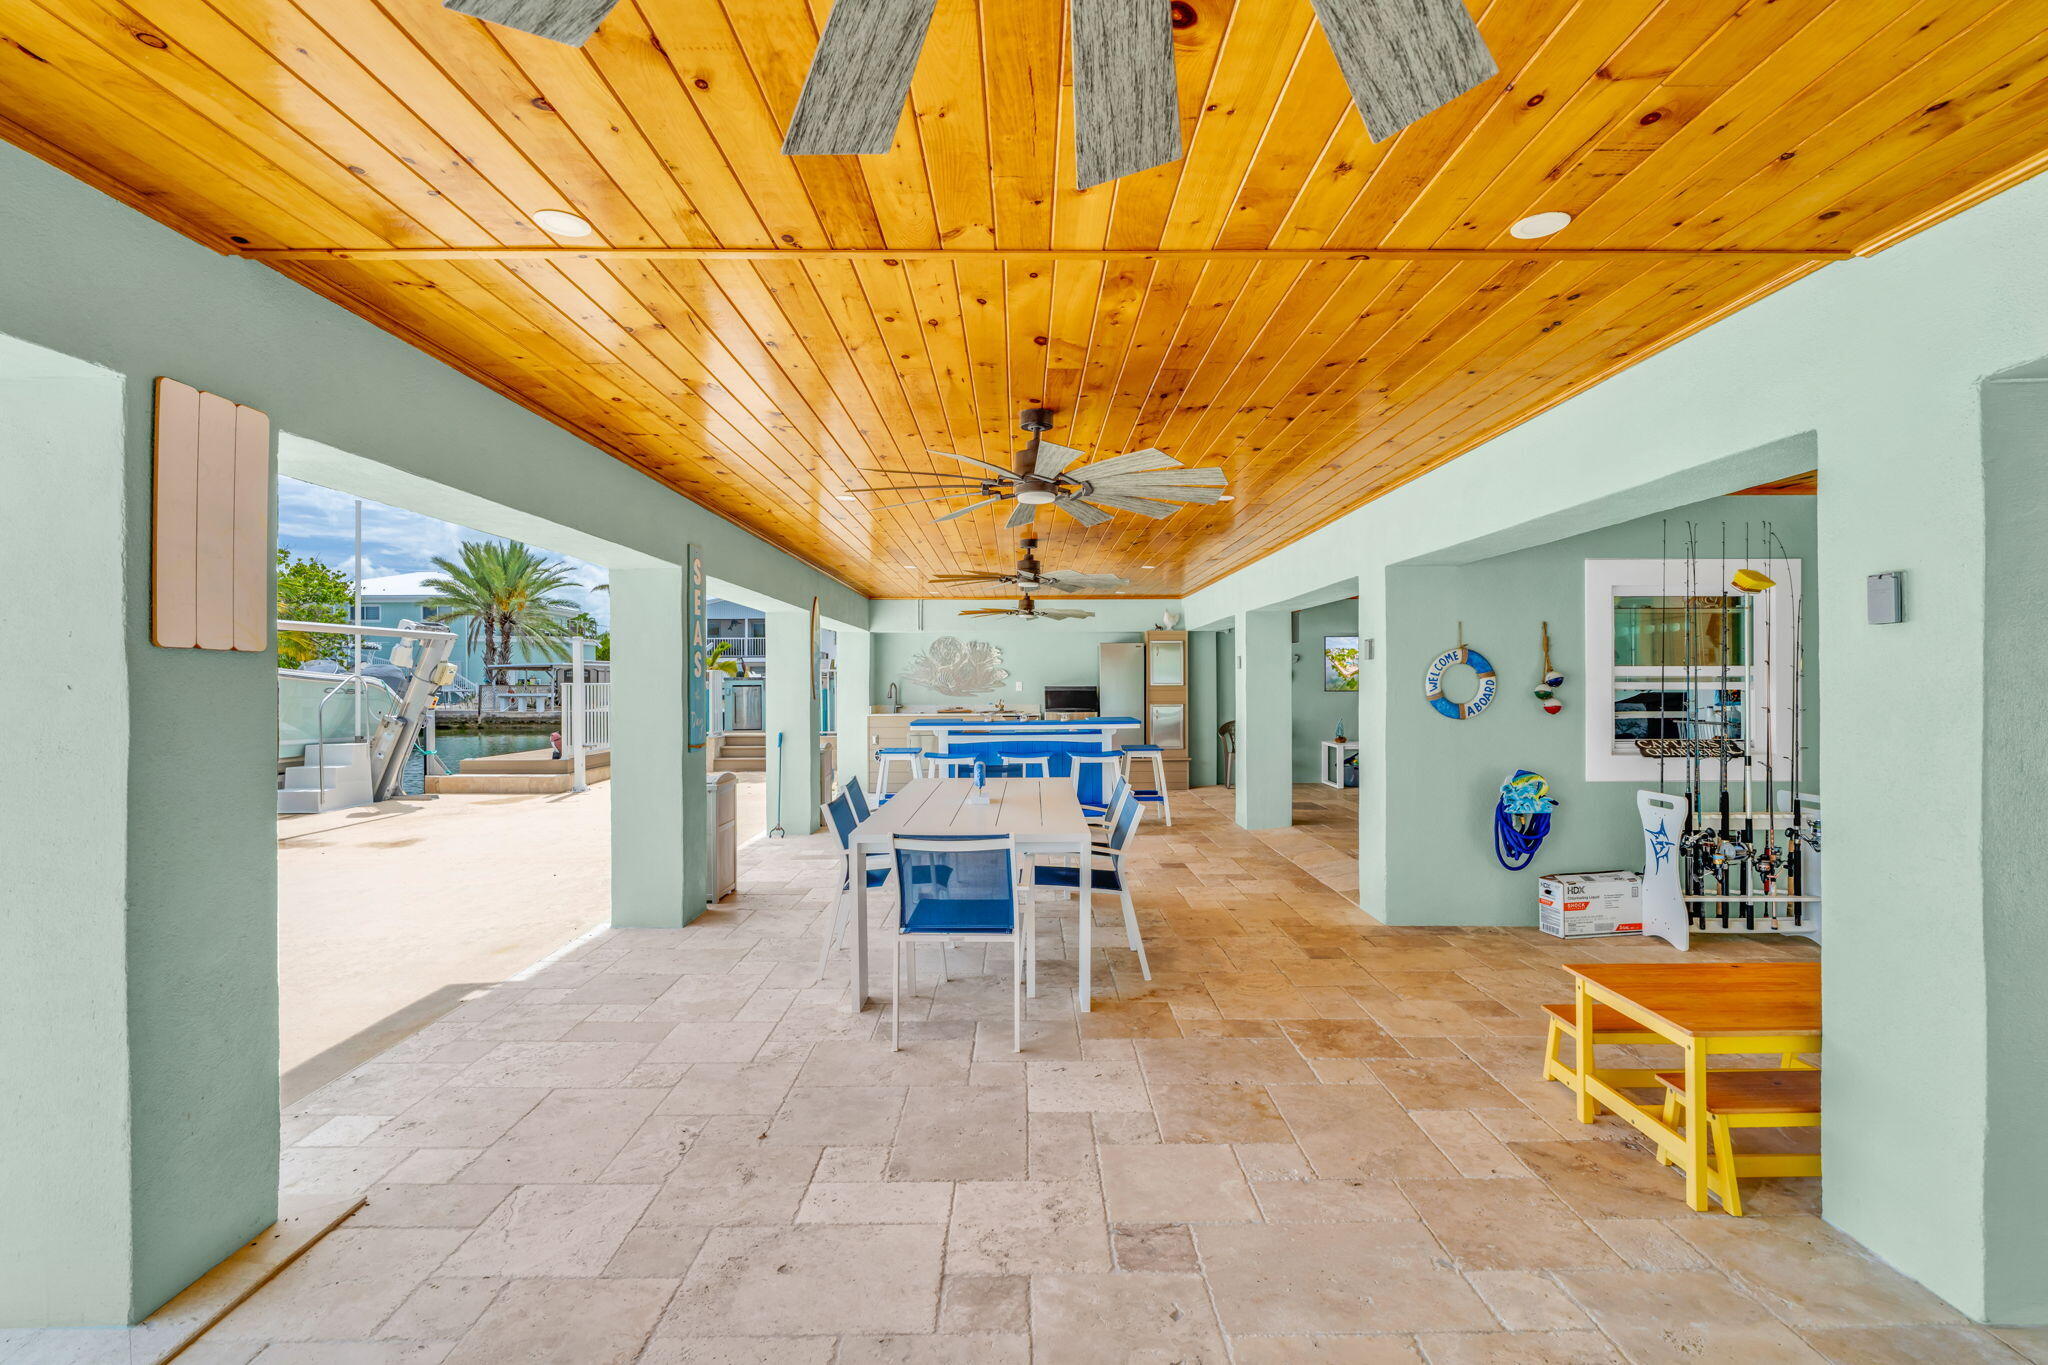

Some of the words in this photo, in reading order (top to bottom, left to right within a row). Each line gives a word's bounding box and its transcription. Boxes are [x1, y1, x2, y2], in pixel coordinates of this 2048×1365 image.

[693, 558, 703, 678] SEAS
[1428, 650, 1459, 693] WELCOME
[1467, 679, 1495, 717] ABOARD
[1567, 885, 1586, 895] HDX
